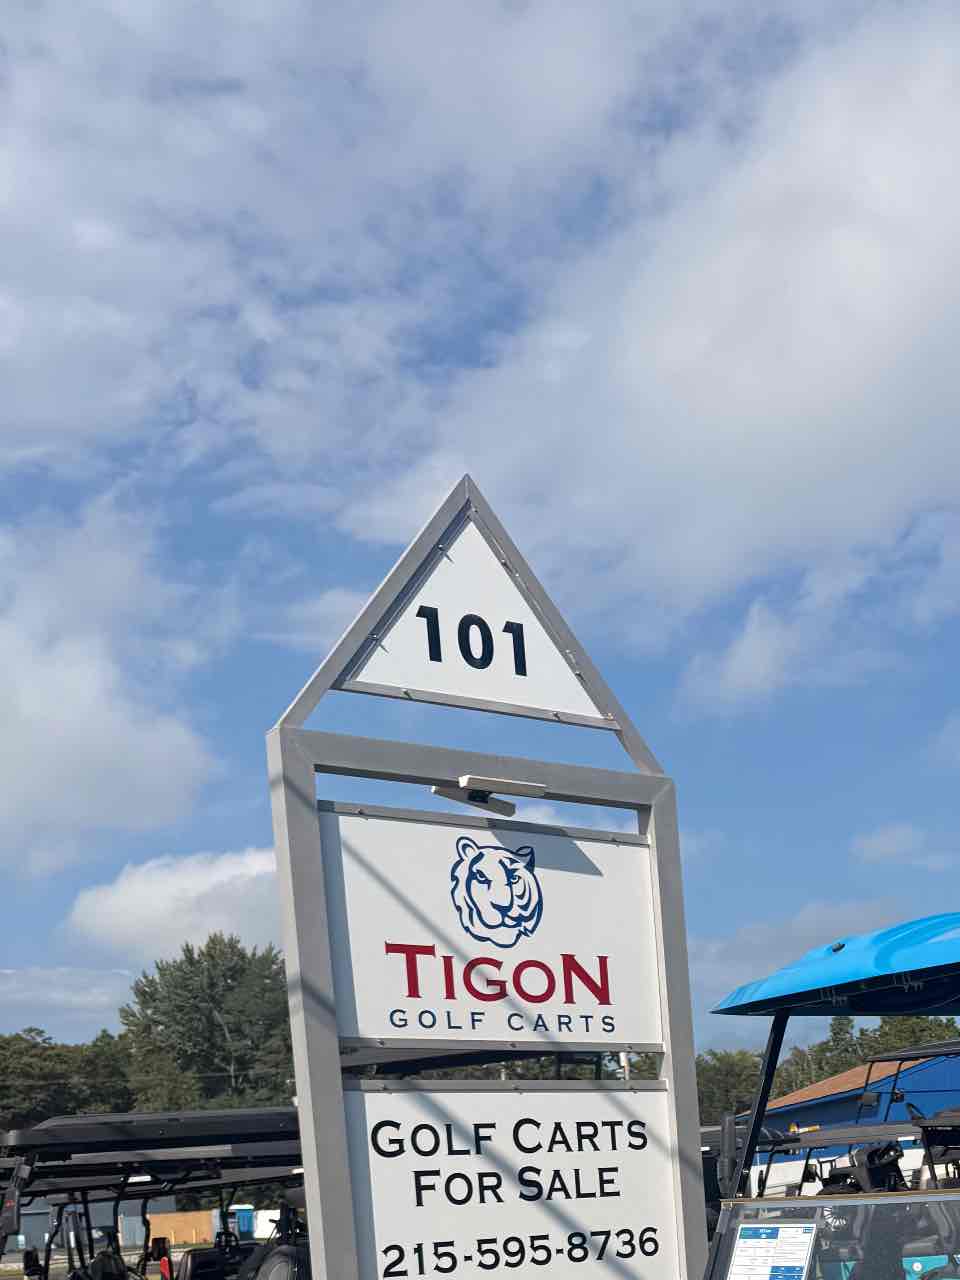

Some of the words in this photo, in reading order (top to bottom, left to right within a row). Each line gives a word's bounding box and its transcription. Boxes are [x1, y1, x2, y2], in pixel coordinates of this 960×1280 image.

[416, 605, 528, 677] 101
[384, 941, 614, 1006] TIGON
[389, 1009, 486, 1031] GOLF
[508, 1013, 616, 1034] CARTS
[371, 1119, 497, 1158] GOLF
[512, 1118, 649, 1154] CARTS
[413, 1169, 505, 1207] FOR
[518, 1165, 621, 1202] SALE
[383, 1227, 660, 1279] 215-595-8736
